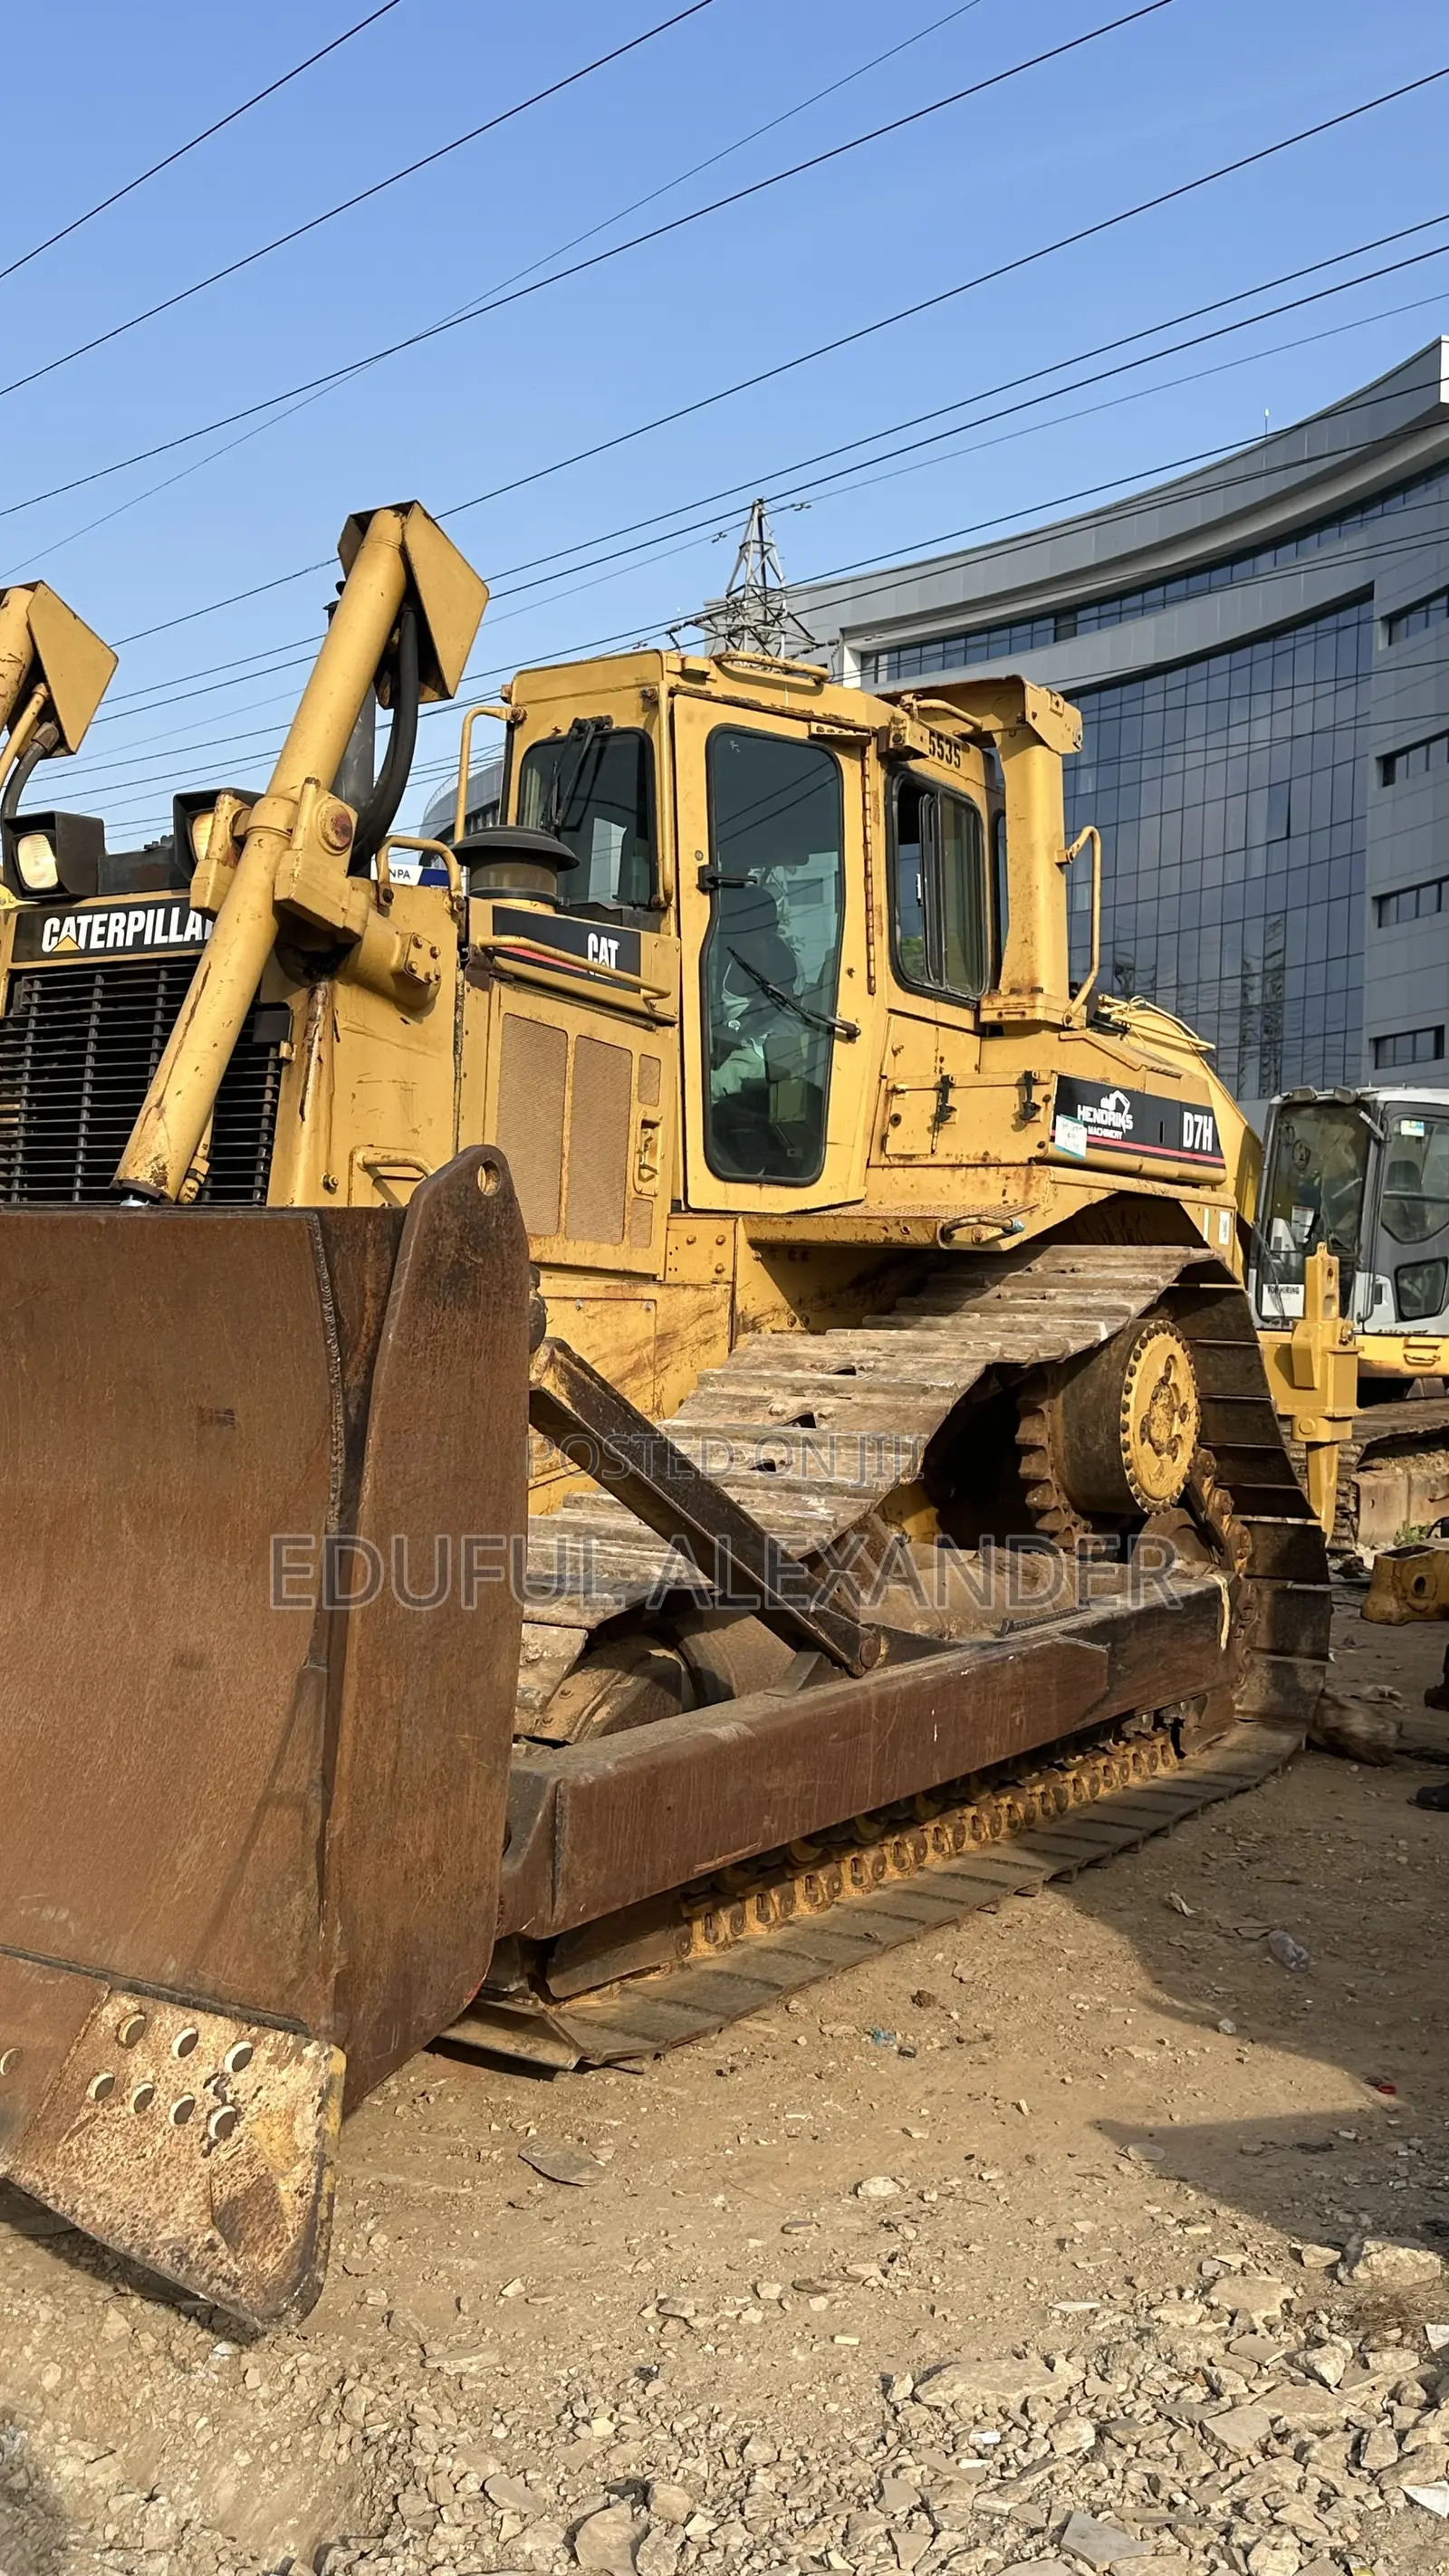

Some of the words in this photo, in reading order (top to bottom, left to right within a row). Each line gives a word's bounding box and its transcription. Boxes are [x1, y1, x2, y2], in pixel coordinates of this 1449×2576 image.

[928, 730, 961, 769] 5535
[587, 932, 619, 981] CAT
[1077, 1104, 1134, 1131] HENDRIKS
[1087, 1125, 1123, 1140] MACHINERY
[1182, 1111, 1214, 1152] D7H
